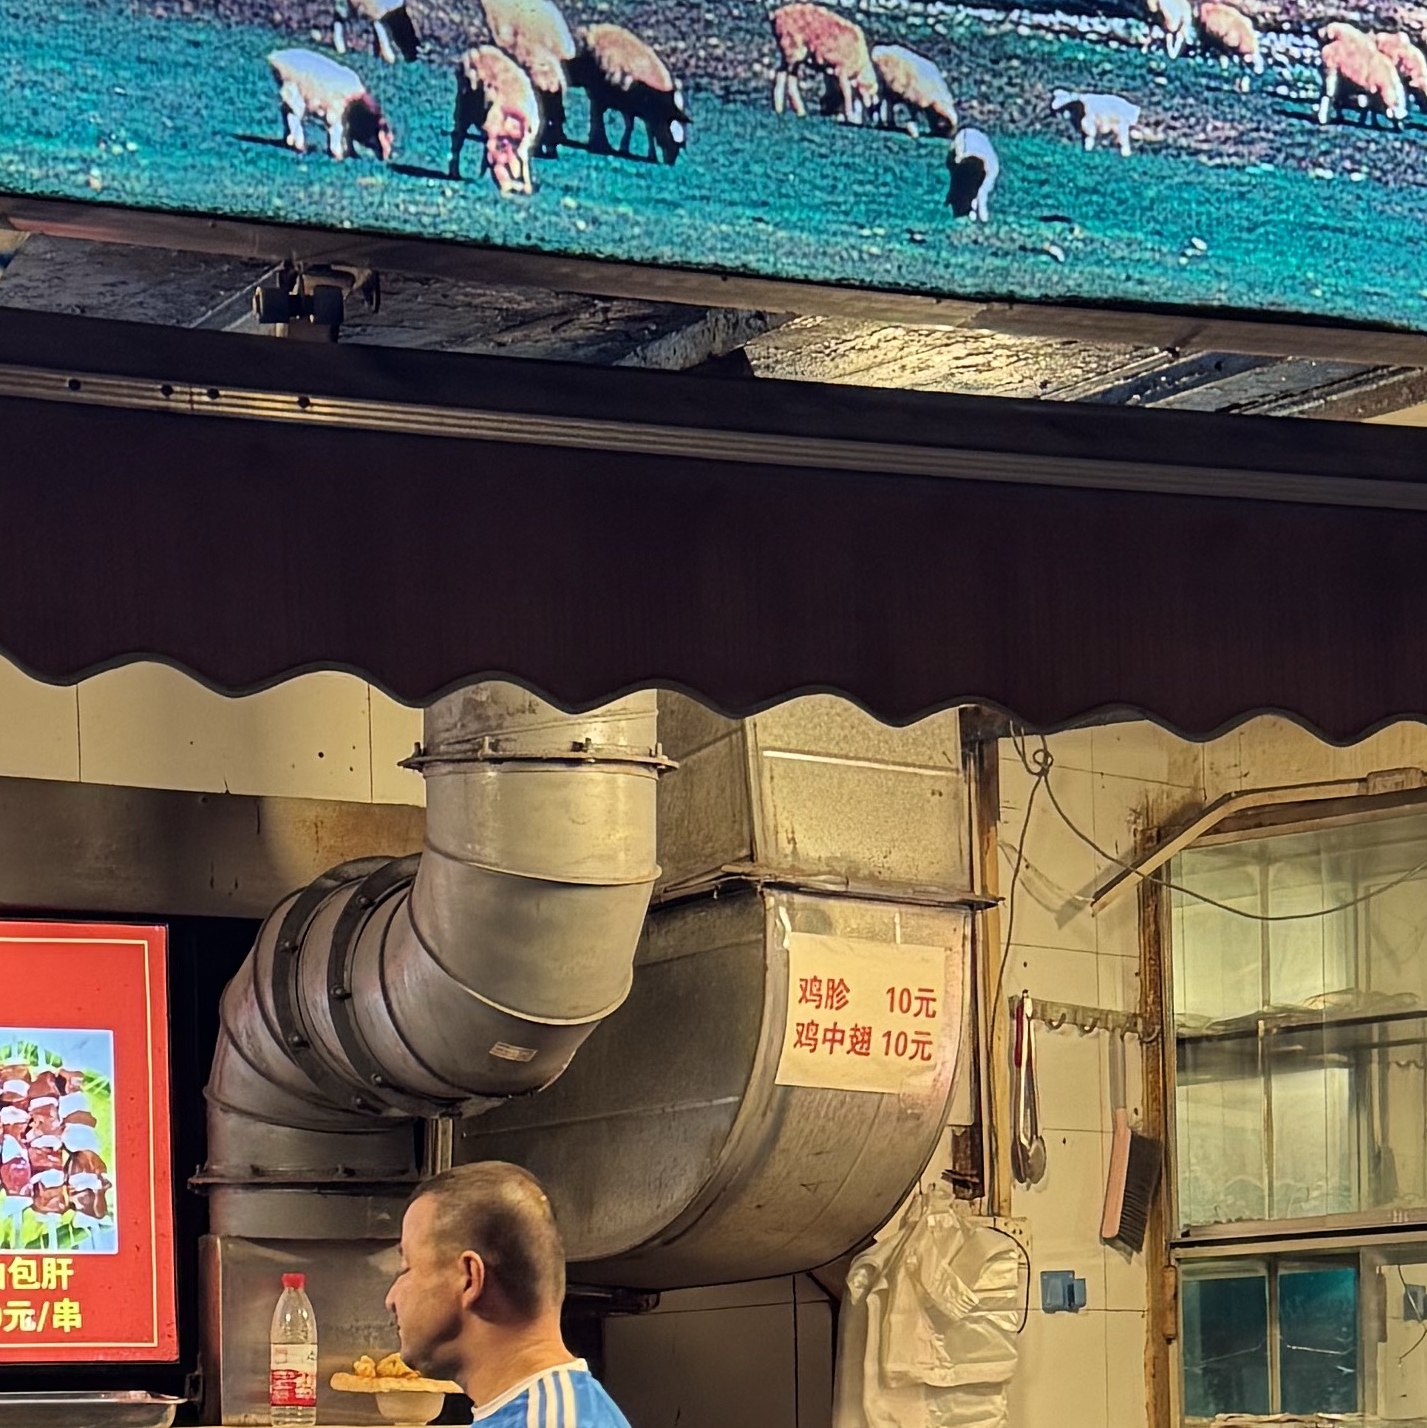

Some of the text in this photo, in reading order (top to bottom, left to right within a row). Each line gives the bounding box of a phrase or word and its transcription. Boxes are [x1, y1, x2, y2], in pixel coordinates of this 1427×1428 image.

[798, 974, 938, 1019] 鸡胗 10元
[793, 1019, 934, 1062] 鸡中翅 10元
